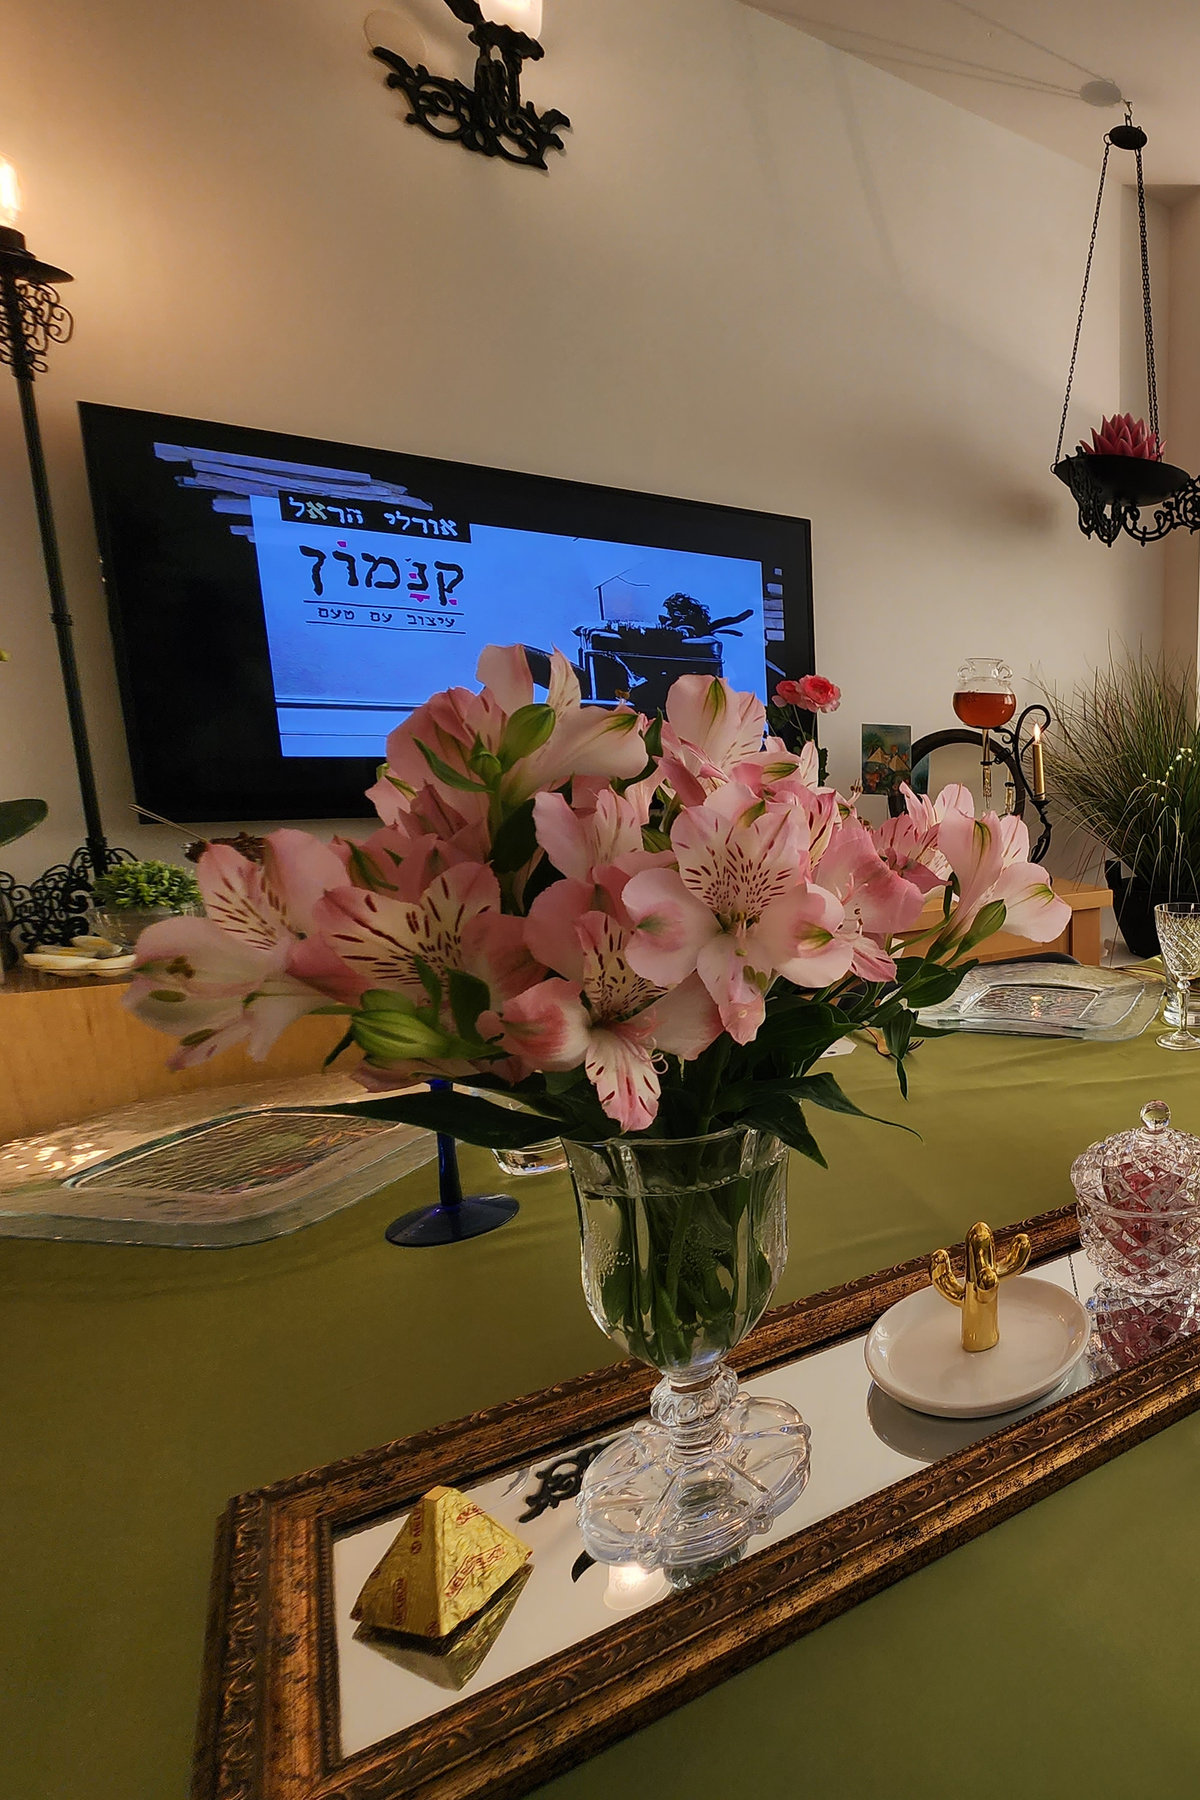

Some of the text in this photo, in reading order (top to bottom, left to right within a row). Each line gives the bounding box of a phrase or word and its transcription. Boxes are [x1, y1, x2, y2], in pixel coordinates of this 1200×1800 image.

[288, 496, 458, 537] אורלי הראל
[317, 607, 456, 628] עיצוב עם טעם
